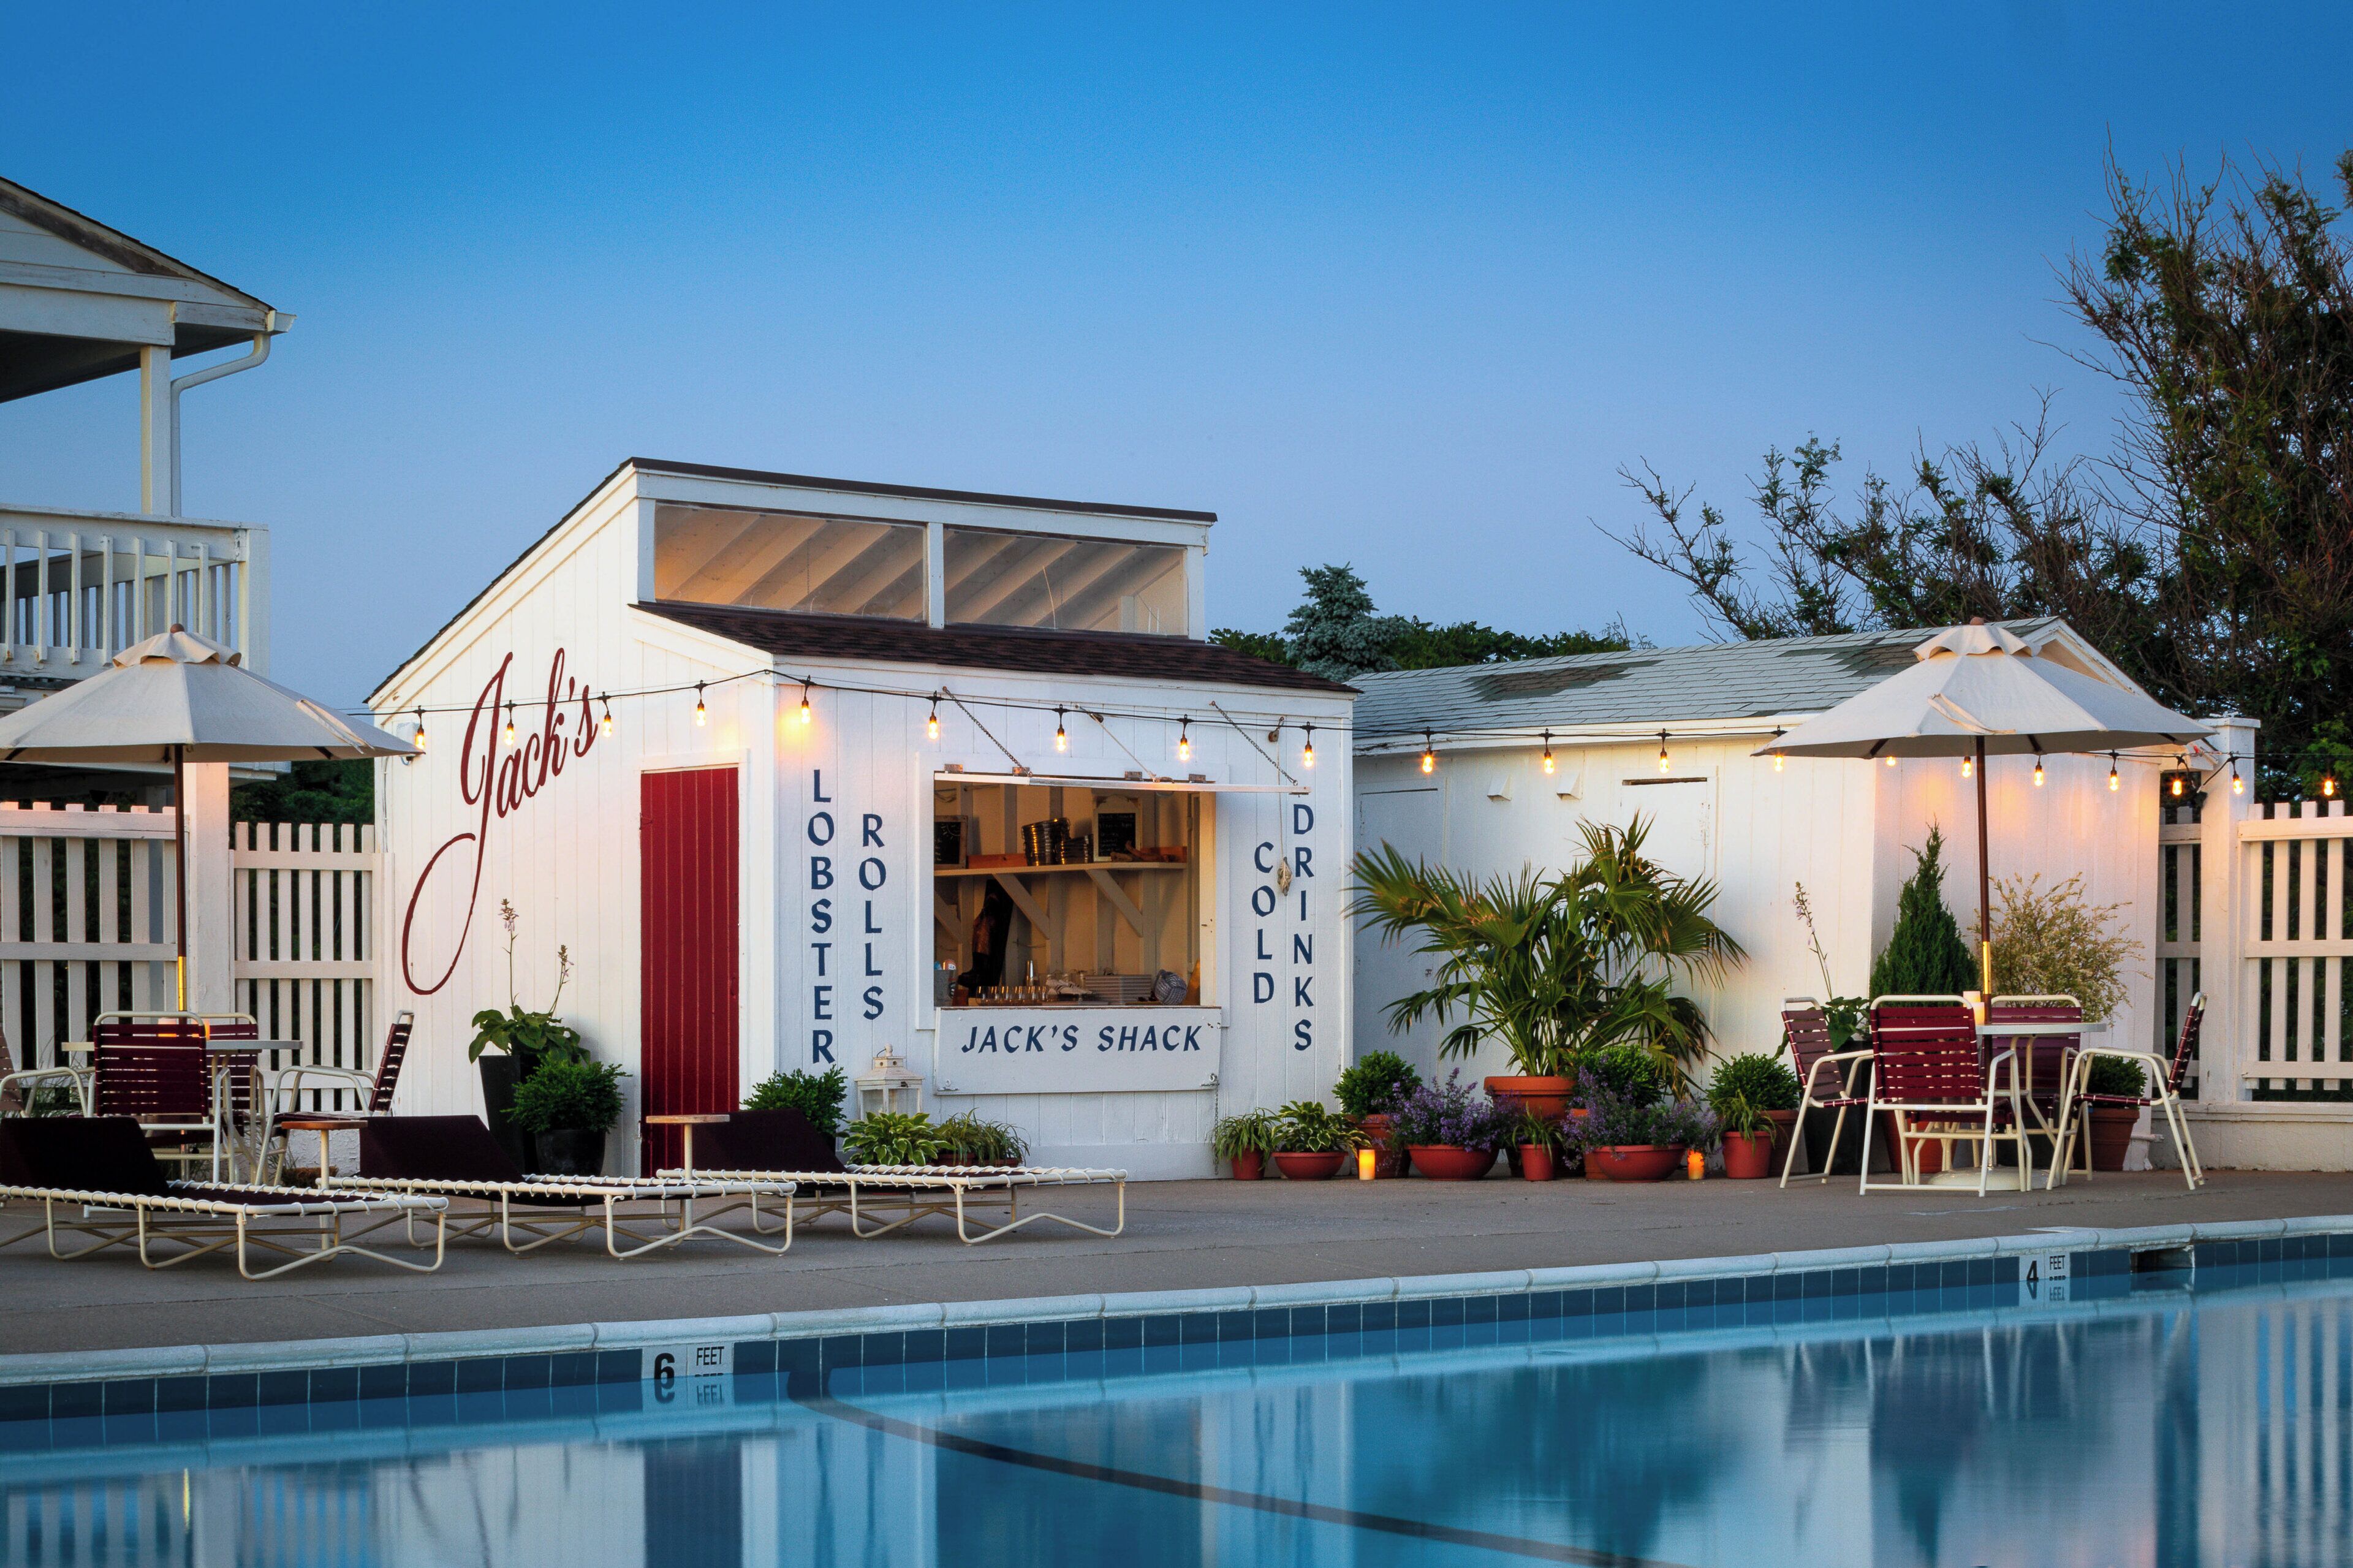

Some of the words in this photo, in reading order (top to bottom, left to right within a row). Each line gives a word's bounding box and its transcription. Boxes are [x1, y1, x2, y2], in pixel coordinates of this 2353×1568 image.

[401, 647, 598, 995] Jack's
[807, 769, 836, 1064] LOBSTER
[858, 813, 887, 1021] ROLLS
[1251, 841, 1276, 1004] COLD
[1293, 803, 1314, 1051] DRINKS
[961, 1024, 1080, 1054] JACK'S
[1097, 1025, 1203, 1053] SHACK
[2026, 1260, 2039, 1281] 4
[2049, 1255, 2066, 1270] FEET
[654, 1352, 675, 1379] 6
[696, 1346, 725, 1366] FEET
